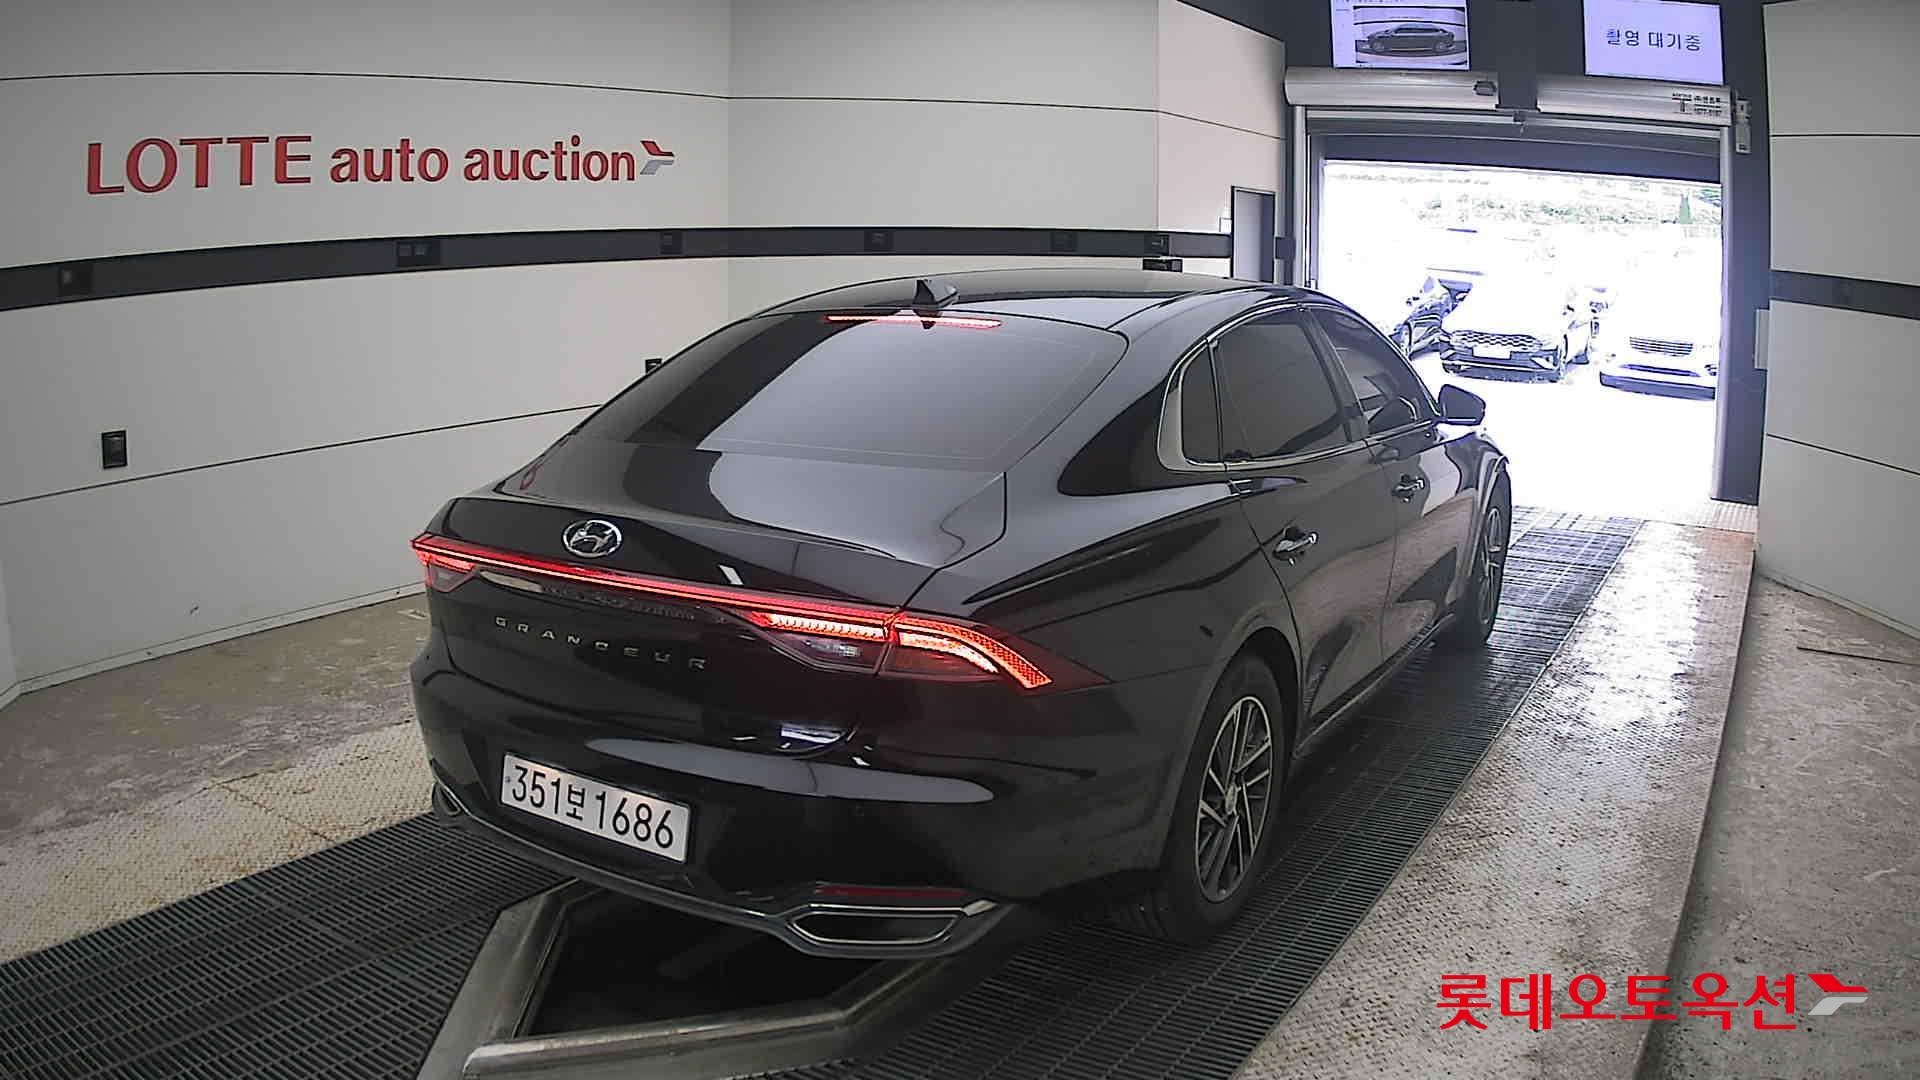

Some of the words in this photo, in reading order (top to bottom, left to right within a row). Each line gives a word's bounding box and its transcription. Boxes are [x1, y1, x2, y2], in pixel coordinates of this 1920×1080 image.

[1648, 31, 1701, 51] 대기중
[87, 136, 312, 195] LOTTE
[330, 138, 450, 183] auto
[463, 136, 637, 182] auction
[495, 616, 706, 670] GRANDEUR
